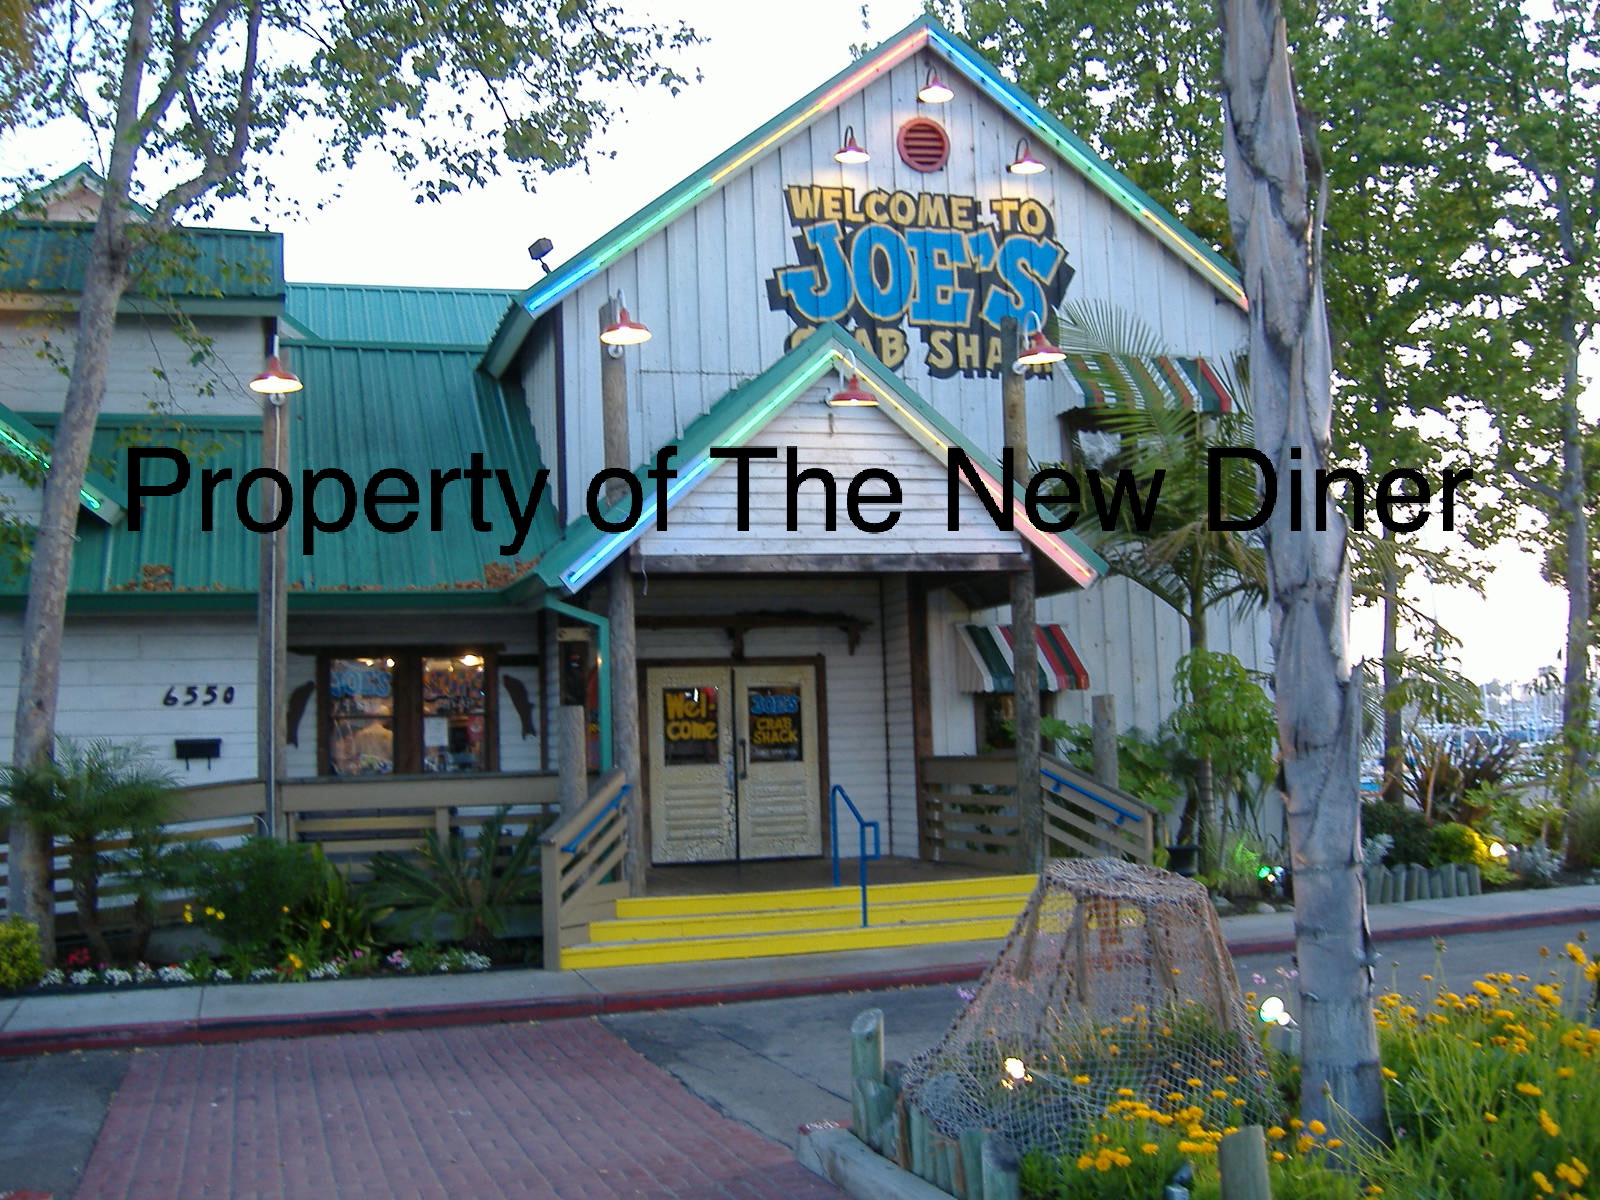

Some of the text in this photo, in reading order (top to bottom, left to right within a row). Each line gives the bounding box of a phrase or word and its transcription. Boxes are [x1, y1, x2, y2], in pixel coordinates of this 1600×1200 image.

[785, 185, 1048, 237] WELCOME TO
[772, 219, 1066, 334] JOE'S
[926, 328, 1054, 376] SHA
[162, 685, 234, 706] 6550
[752, 730, 798, 744] SHACK
[755, 716, 793, 730] CRAB
